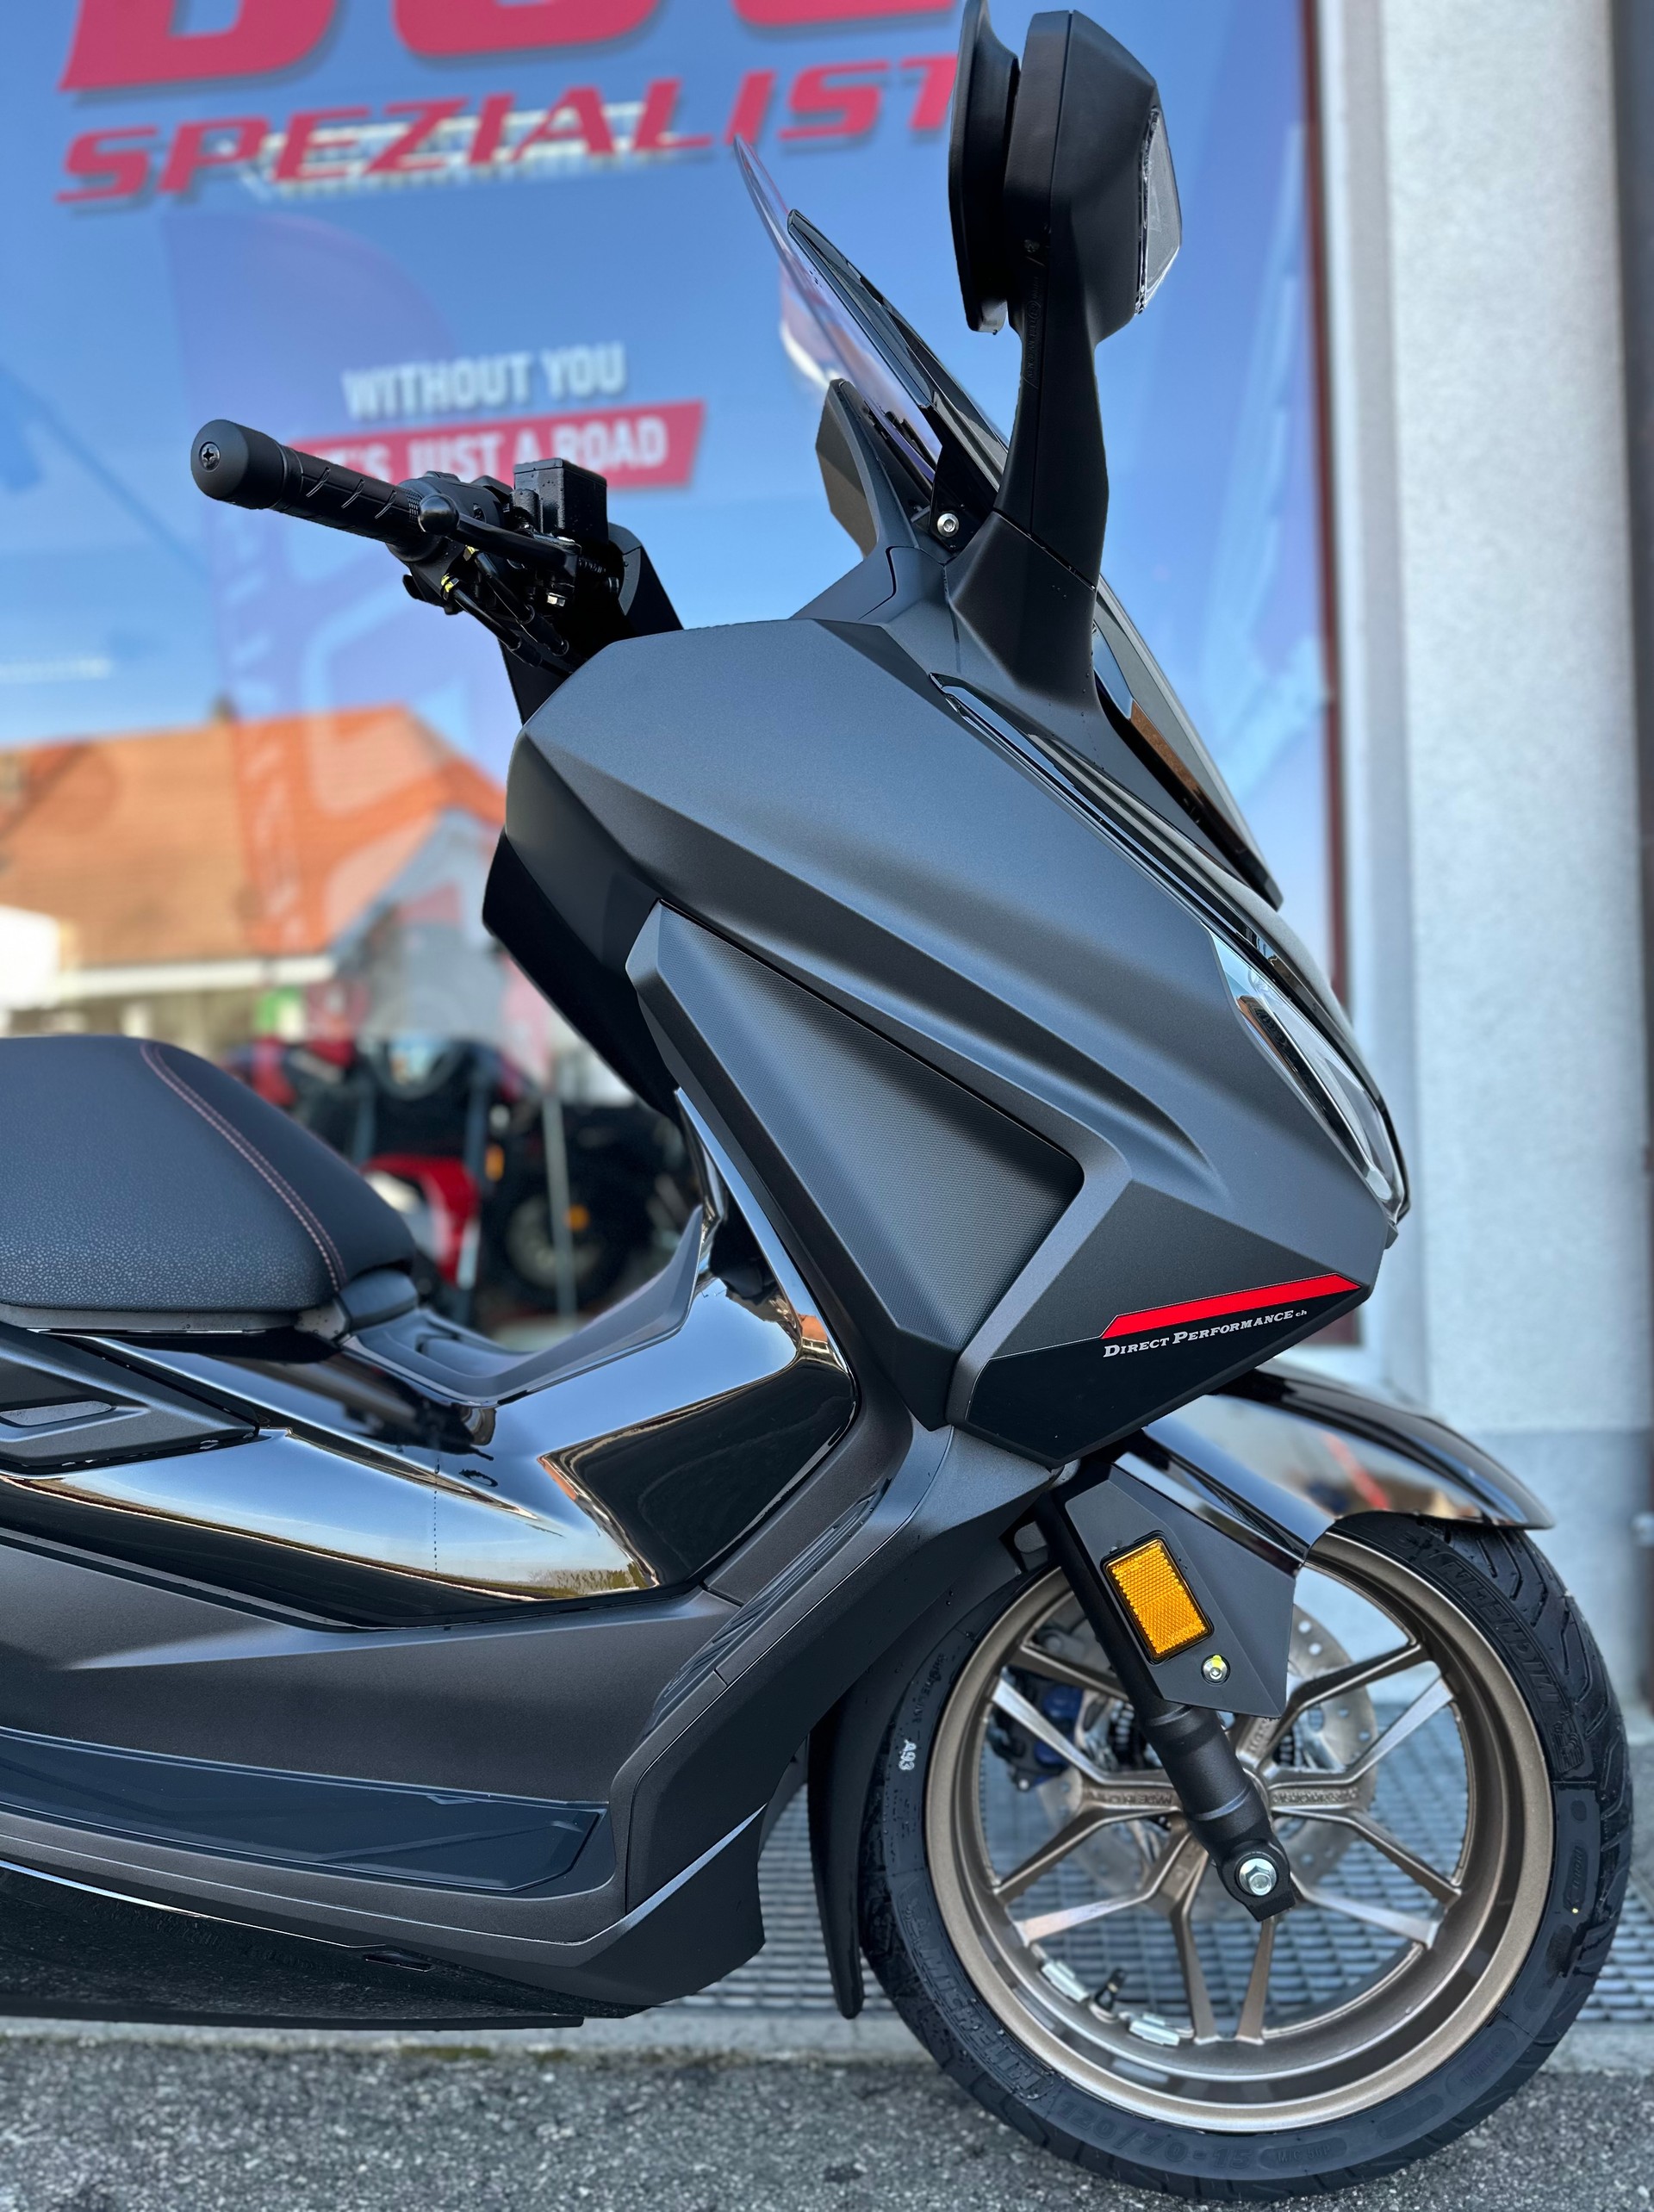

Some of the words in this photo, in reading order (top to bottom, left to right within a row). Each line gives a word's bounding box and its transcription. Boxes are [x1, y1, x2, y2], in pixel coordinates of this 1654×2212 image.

[341, 353, 530, 420] WITHOUT
[541, 343, 625, 399] YOU
[551, 415, 668, 475] ROAD
[1104, 1338, 1169, 1358] DIRECT
[1437, 1560, 1561, 1705] MICHELIN
[899, 1739, 917, 1771] A93
